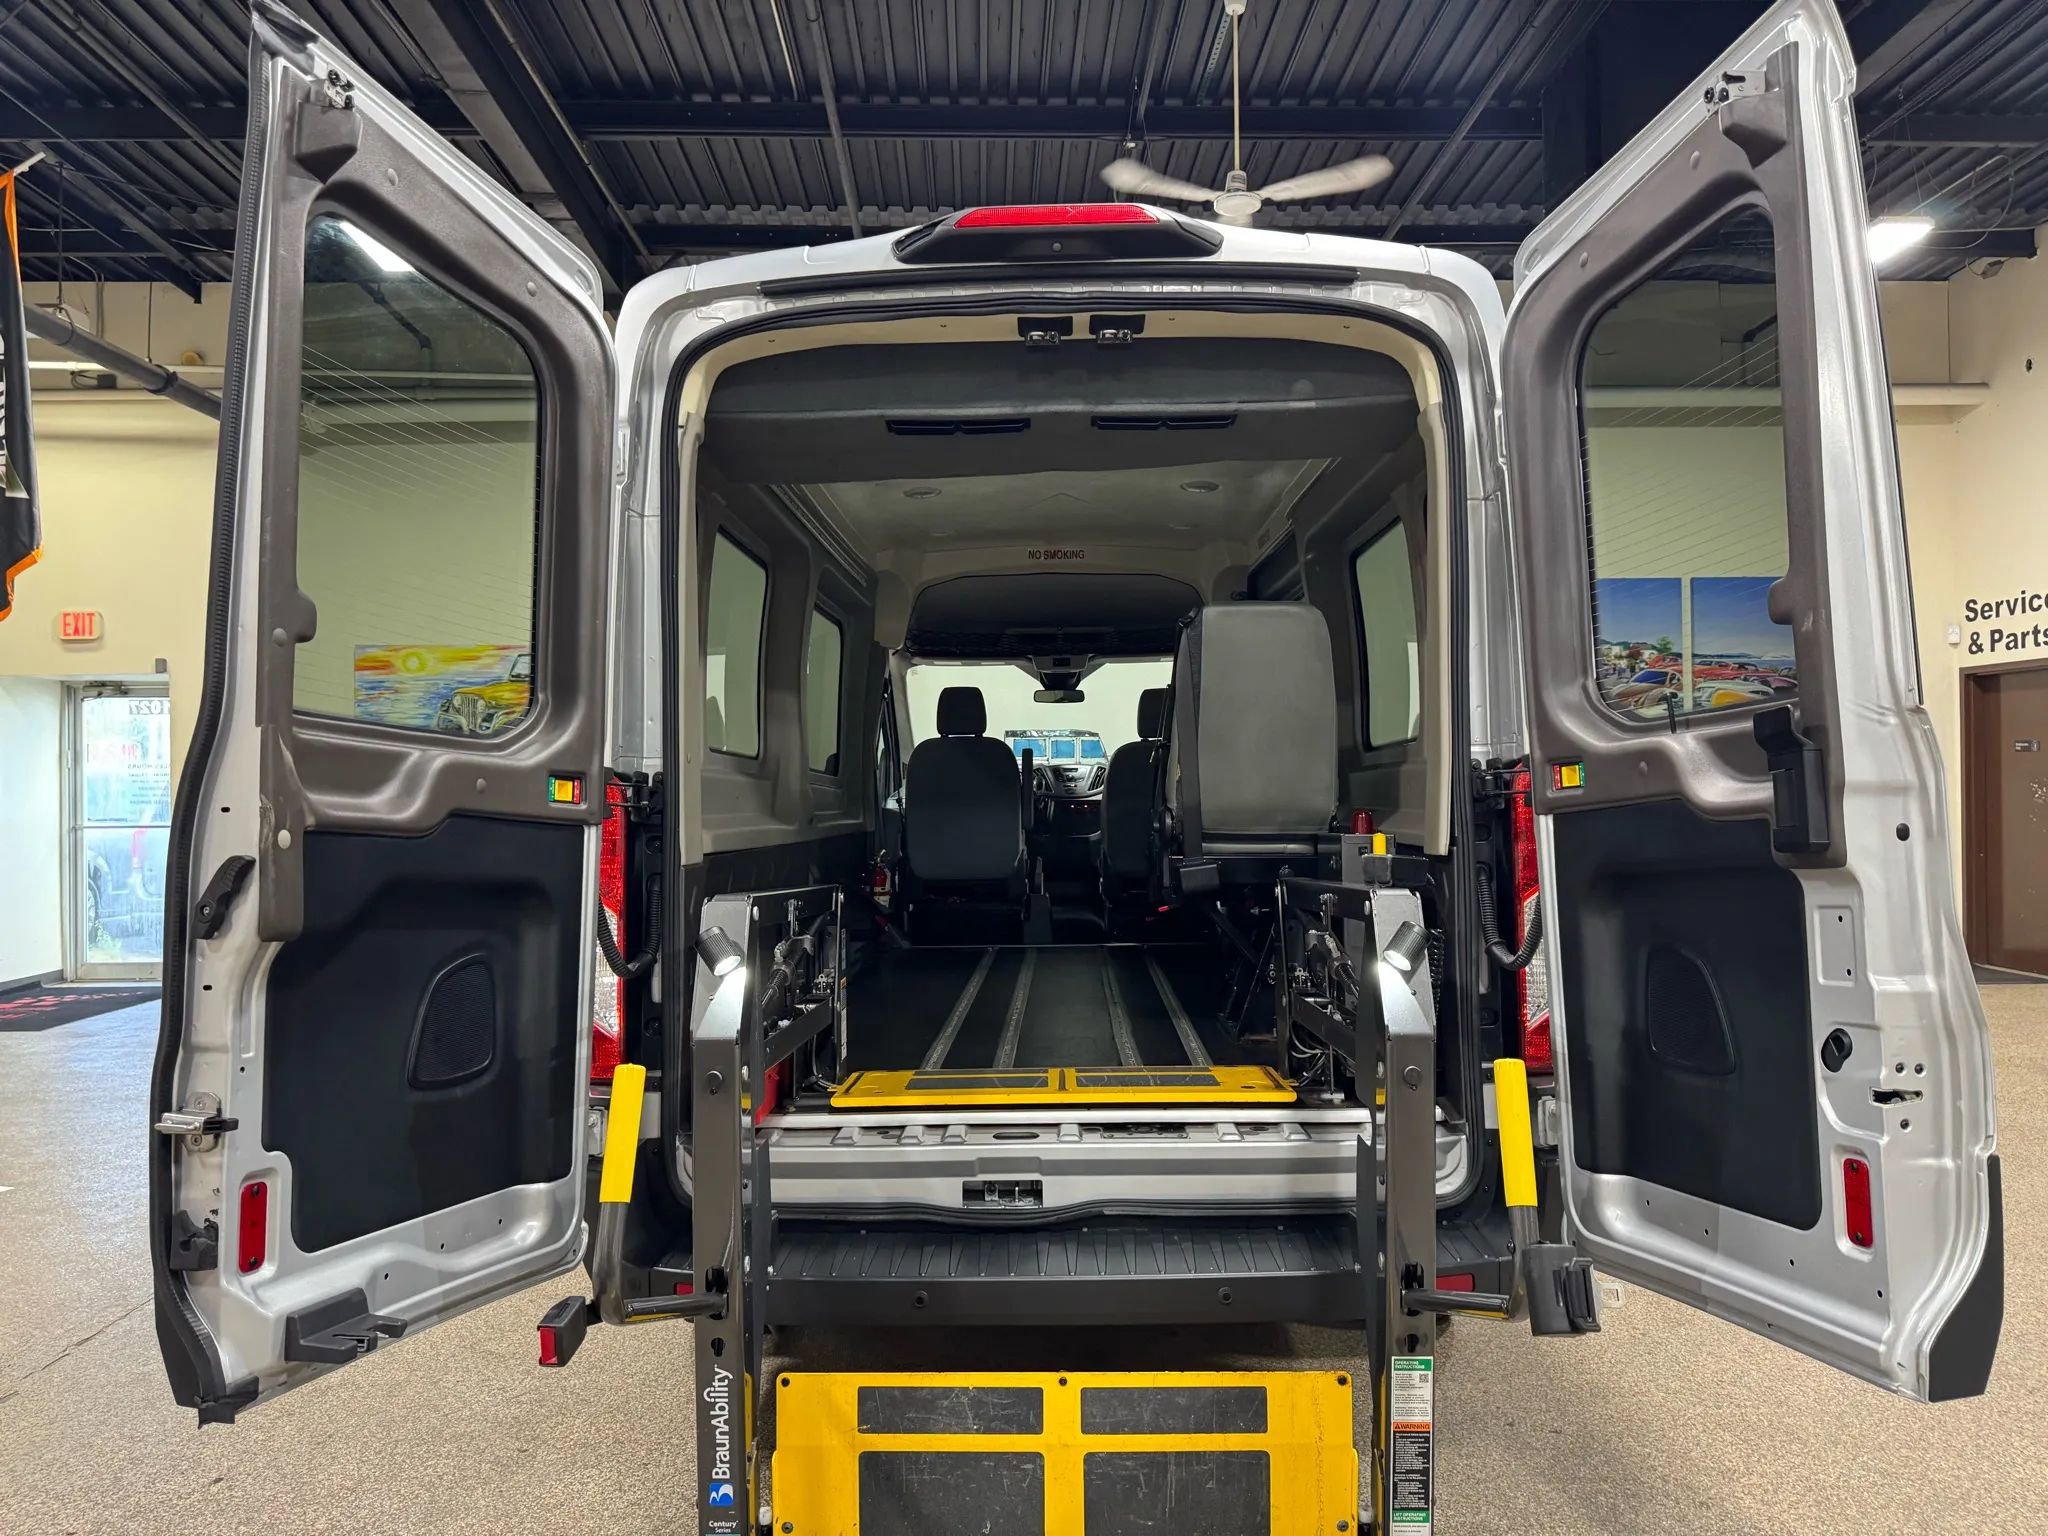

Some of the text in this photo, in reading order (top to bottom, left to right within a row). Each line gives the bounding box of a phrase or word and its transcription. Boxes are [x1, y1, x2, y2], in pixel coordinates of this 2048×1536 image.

[1028, 550, 1085, 560] NO SMOKING
[1965, 590, 2048, 622] Servic
[63, 612, 95, 637] EXIT
[1968, 632, 1984, 655] &
[703, 1366, 734, 1480] BraunAbility
[708, 1520, 737, 1528] Century
